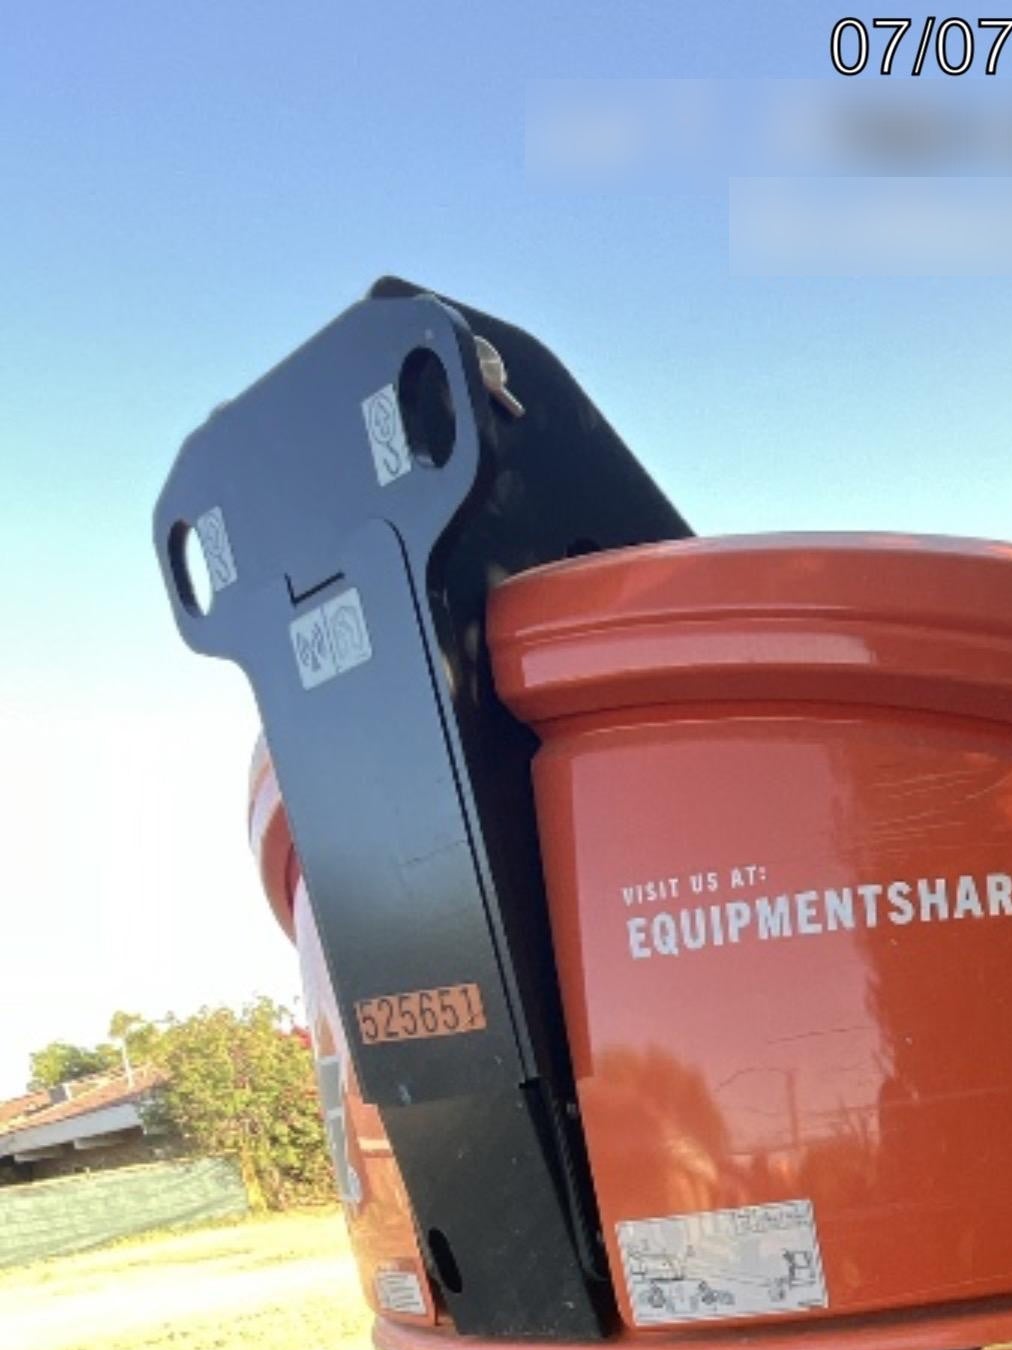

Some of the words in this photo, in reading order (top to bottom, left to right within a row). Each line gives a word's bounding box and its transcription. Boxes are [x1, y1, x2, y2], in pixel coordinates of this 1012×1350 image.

[621, 877, 679, 905] VISIT
[690, 872, 719, 893] US
[730, 865, 768, 889] AT:
[360, 986, 476, 1040] 525651
